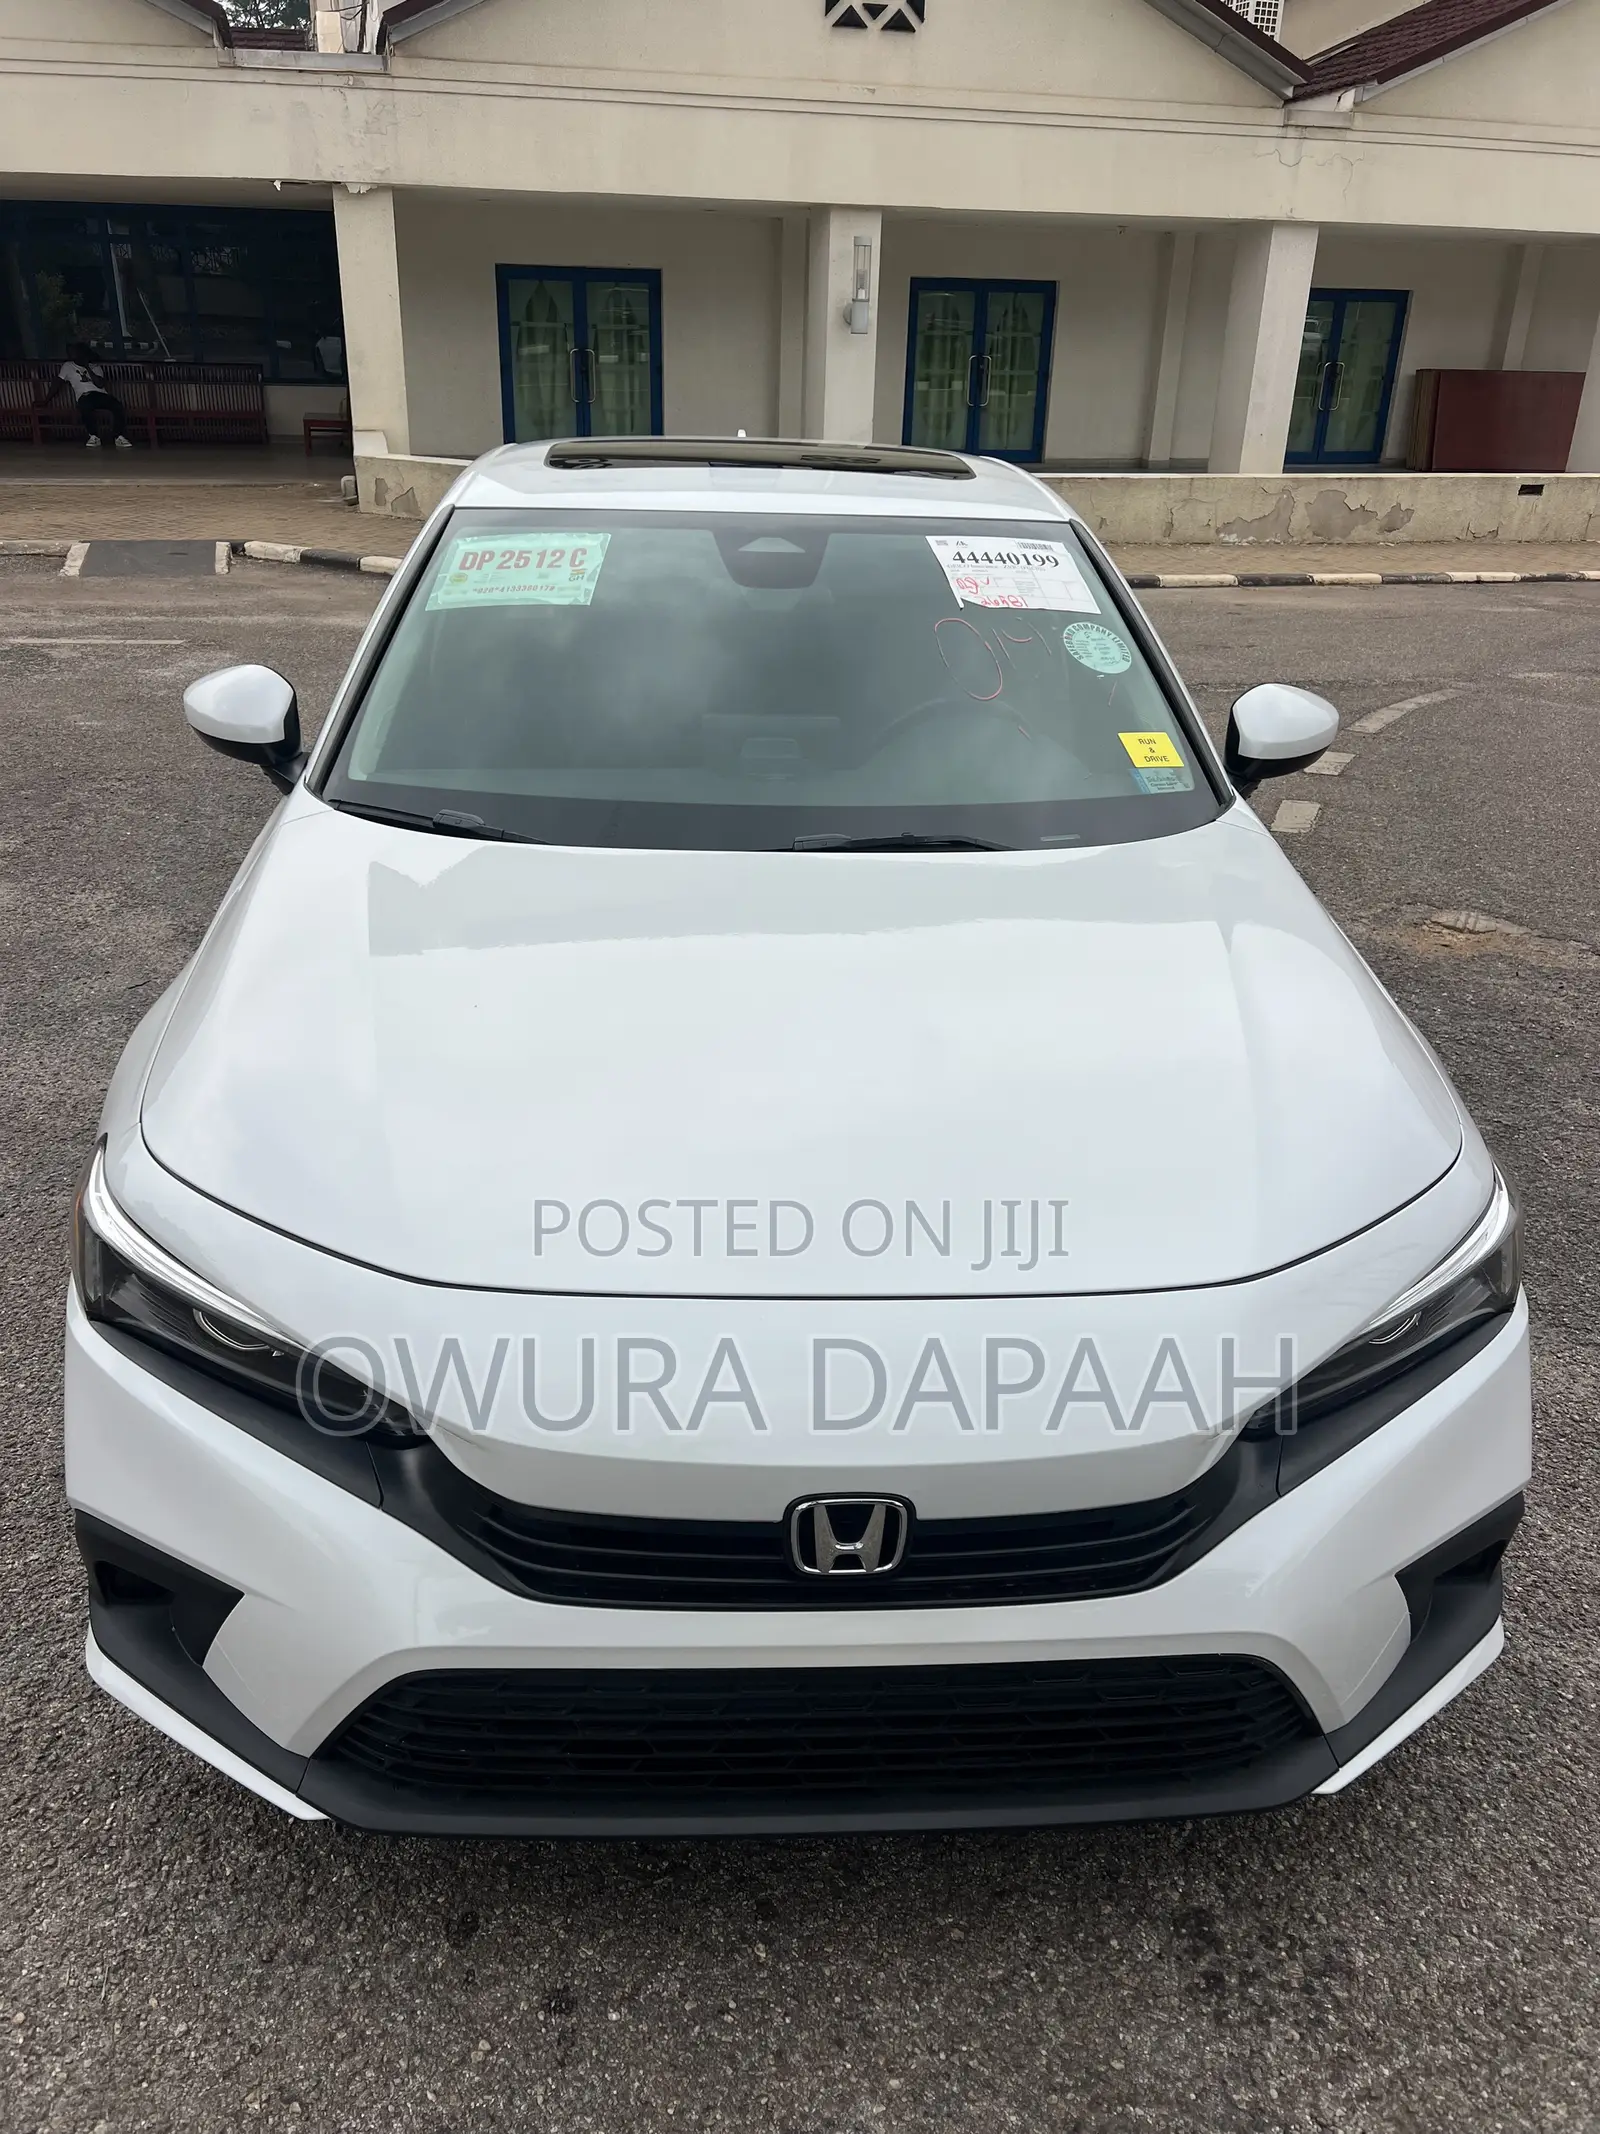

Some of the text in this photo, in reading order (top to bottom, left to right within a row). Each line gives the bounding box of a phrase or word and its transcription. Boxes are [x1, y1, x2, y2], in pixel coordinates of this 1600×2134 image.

[458, 547, 588, 571] DP 2512 C
[952, 550, 1060, 568] 44440199
[568, 574, 585, 582] GH
[1072, 623, 1112, 637] COMPANY
[1112, 637, 1131, 663] LIMITED
